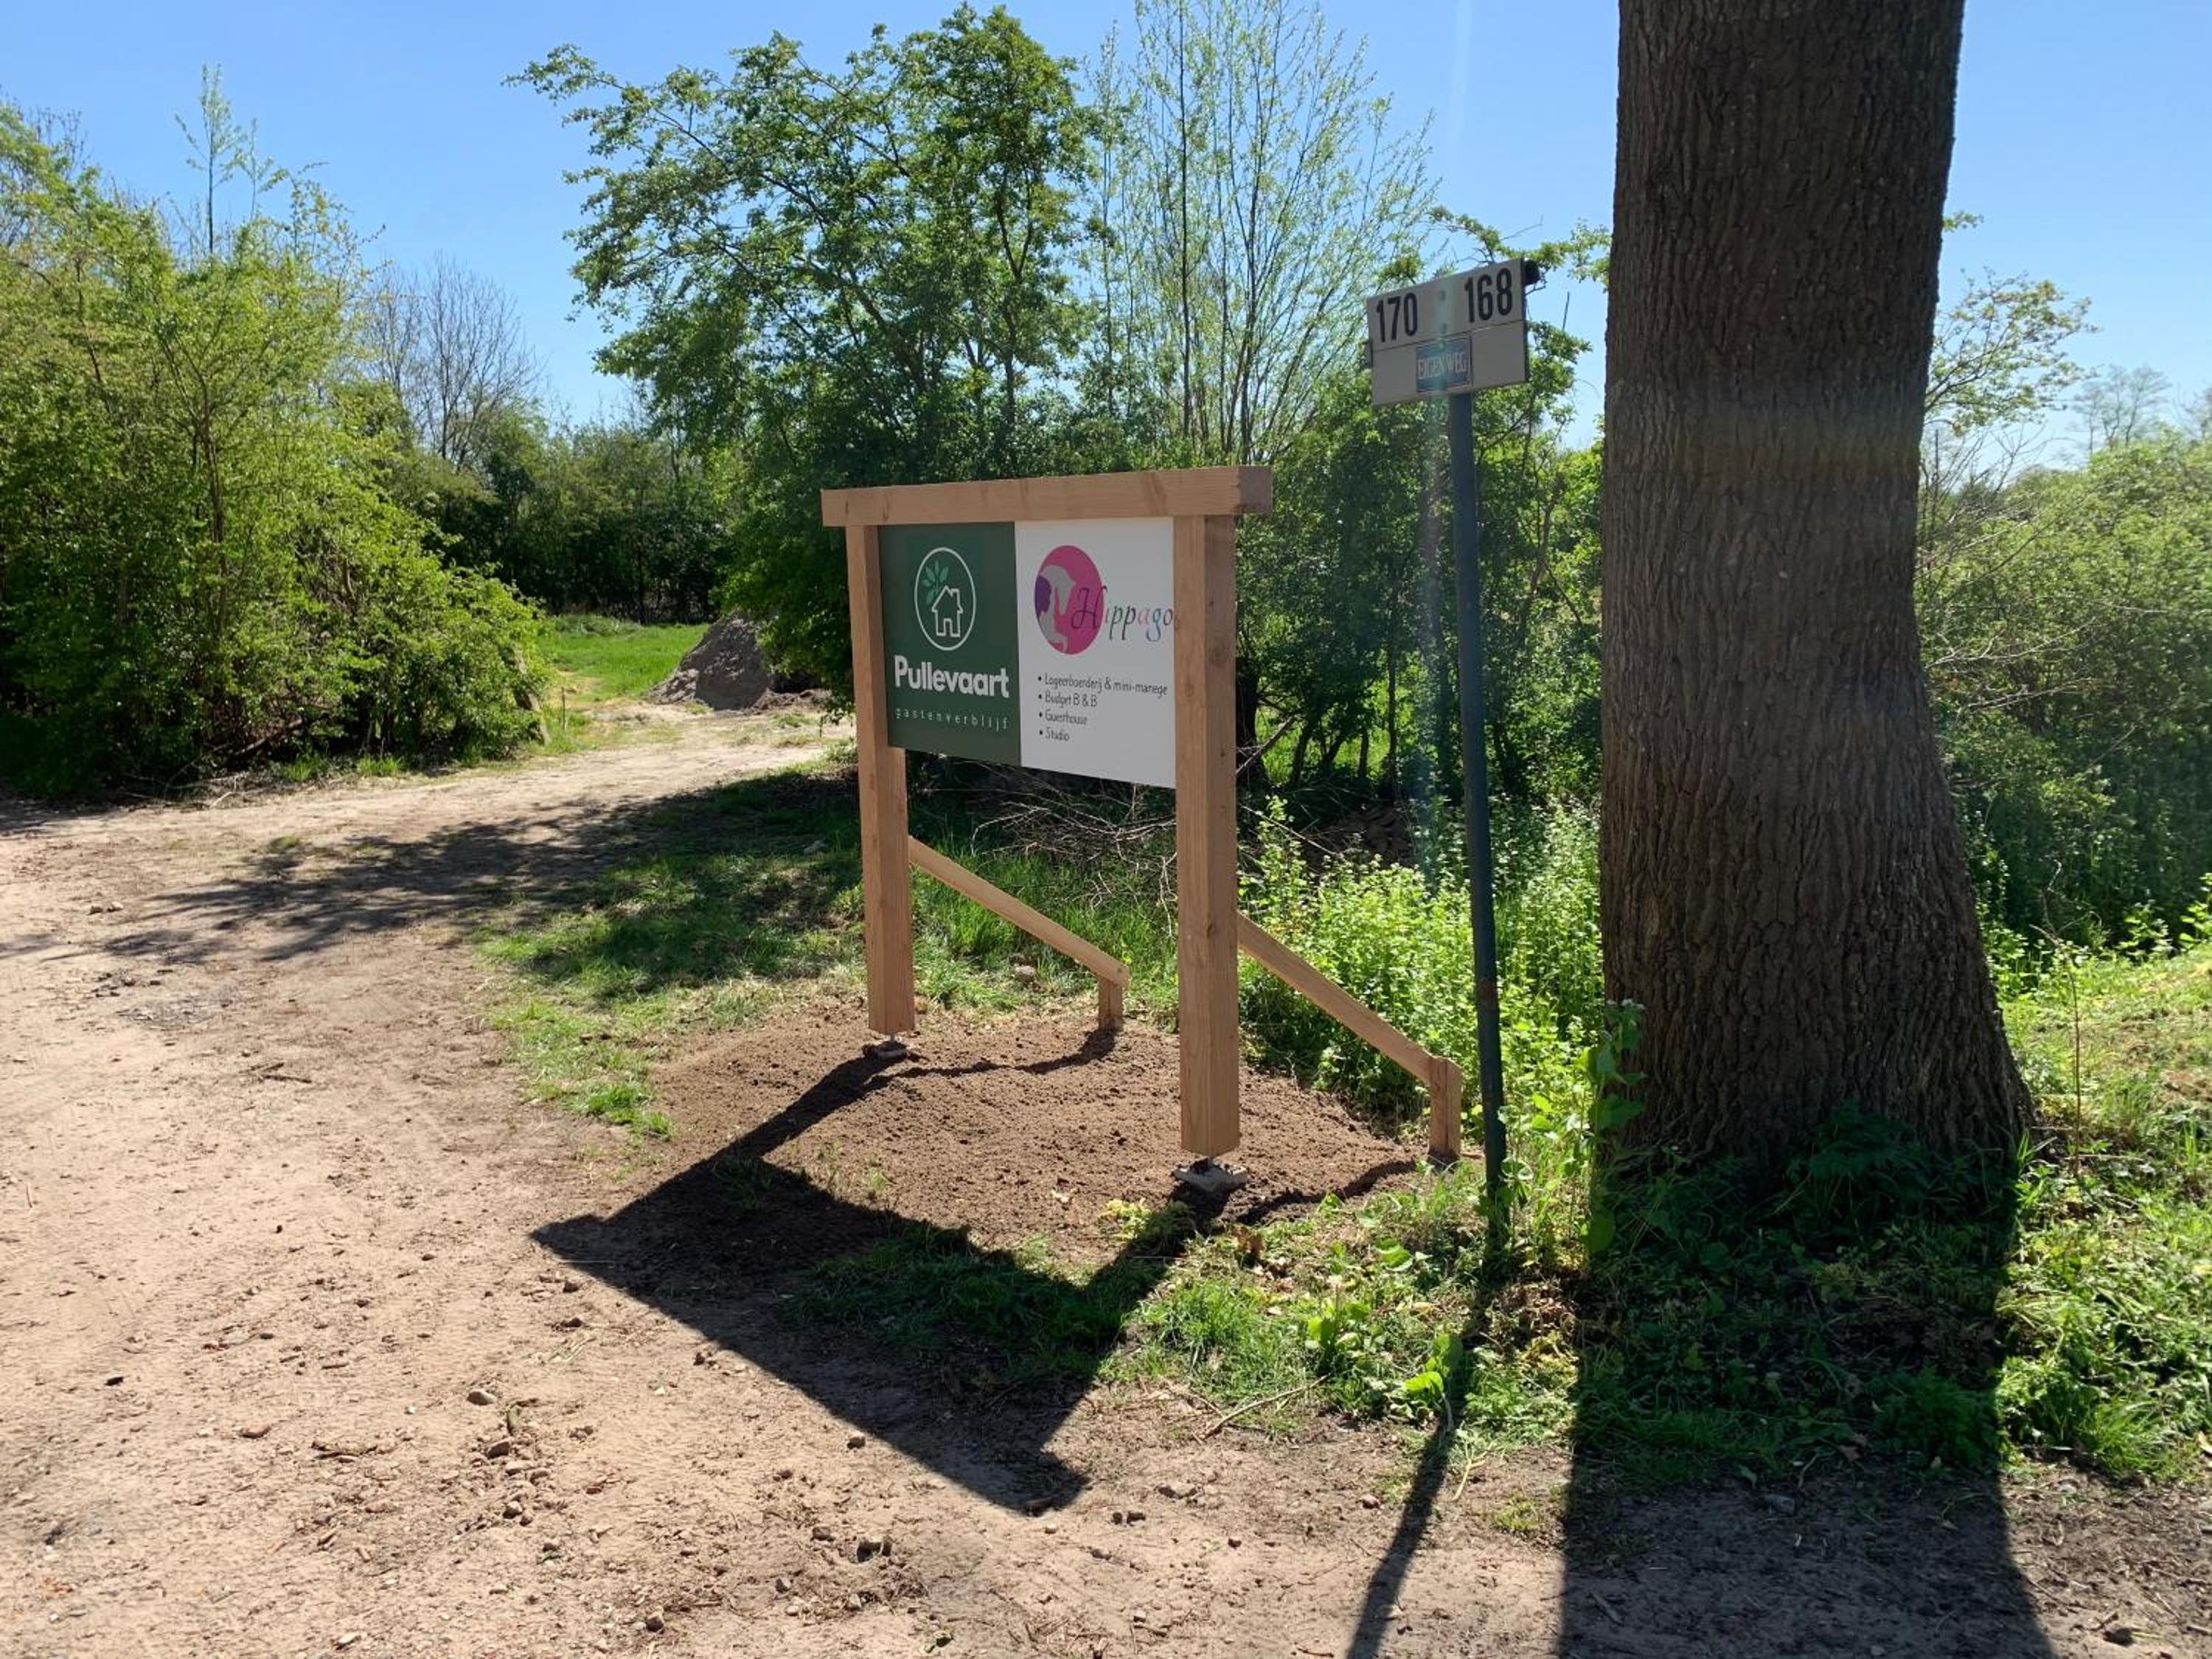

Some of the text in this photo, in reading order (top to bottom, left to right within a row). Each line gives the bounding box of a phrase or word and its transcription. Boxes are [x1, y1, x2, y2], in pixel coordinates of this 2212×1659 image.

[1464, 268, 1512, 323] 168
[1376, 293, 1418, 342] 170
[1071, 585, 1173, 642] Hippago
[894, 654, 1010, 698] Pullevaart
[1104, 677, 1111, 690] &
[1113, 678, 1168, 699] mini-manege
[1044, 689, 1098, 708] Budget B & B
[895, 707, 1009, 731] gastenverblijf
[1044, 709, 1088, 725] Guesthouse
[1044, 726, 1070, 742] Studio
